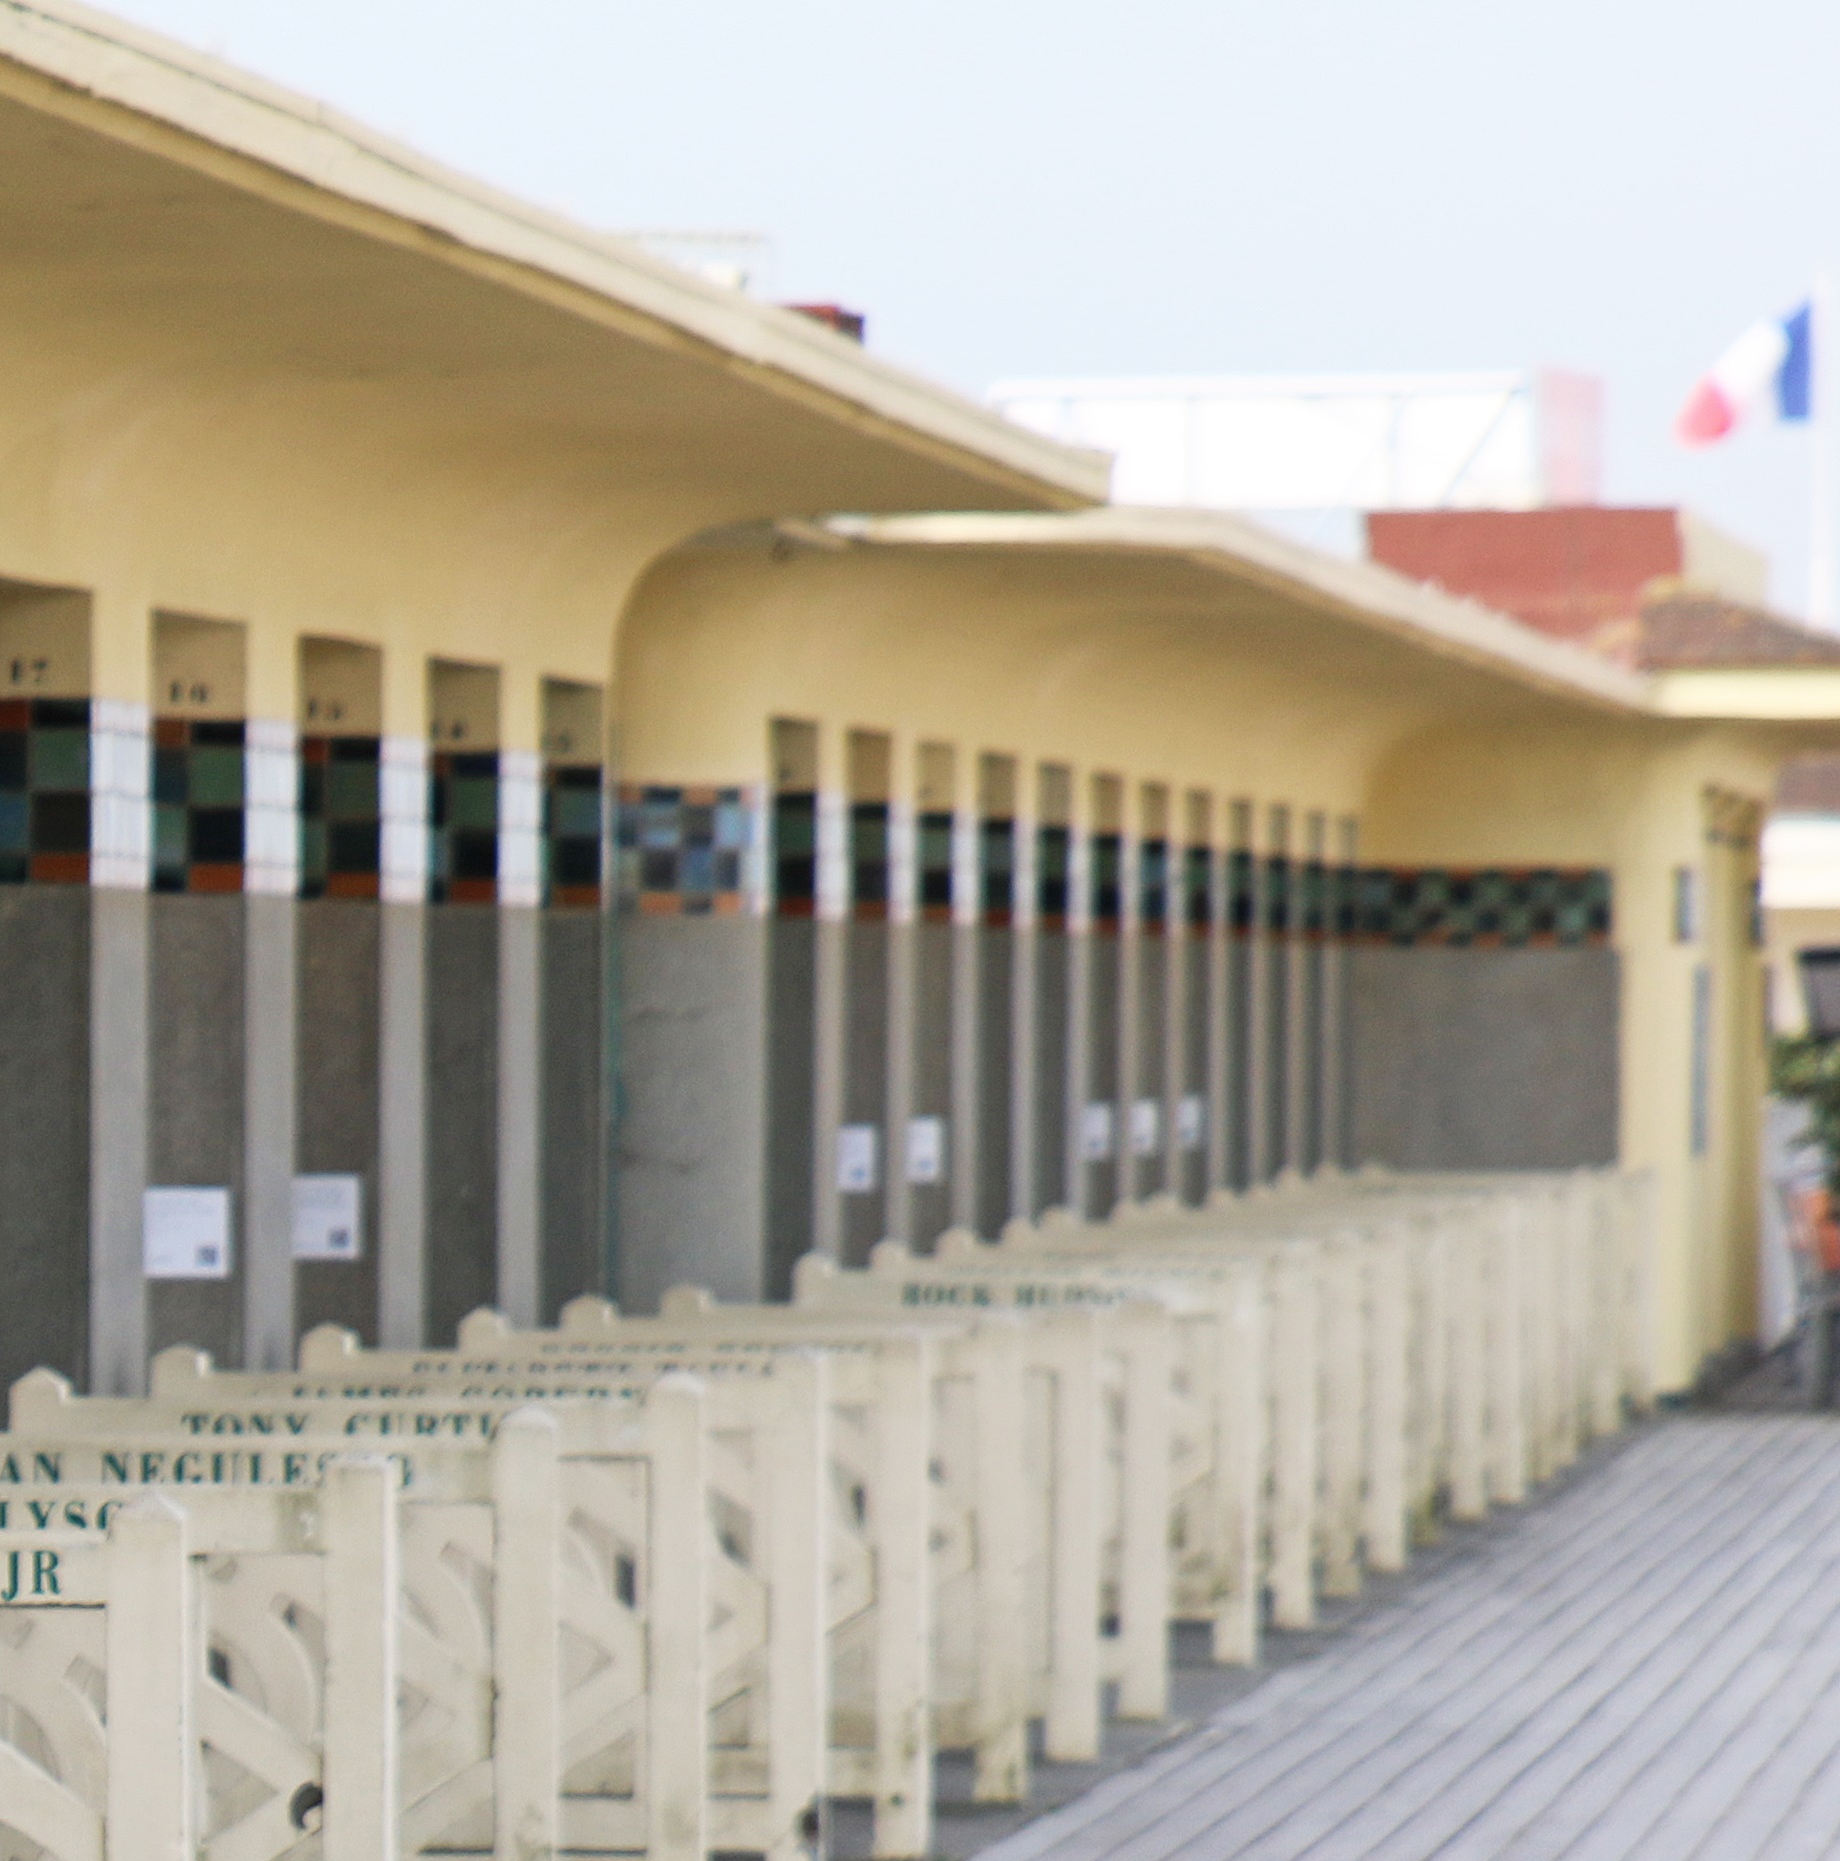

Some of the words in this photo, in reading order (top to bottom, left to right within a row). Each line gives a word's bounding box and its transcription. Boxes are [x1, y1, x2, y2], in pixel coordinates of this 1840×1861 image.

[181, 1412, 307, 1435] TONY
[343, 1411, 495, 1436] CURTI
[1, 1550, 62, 1602] JR
